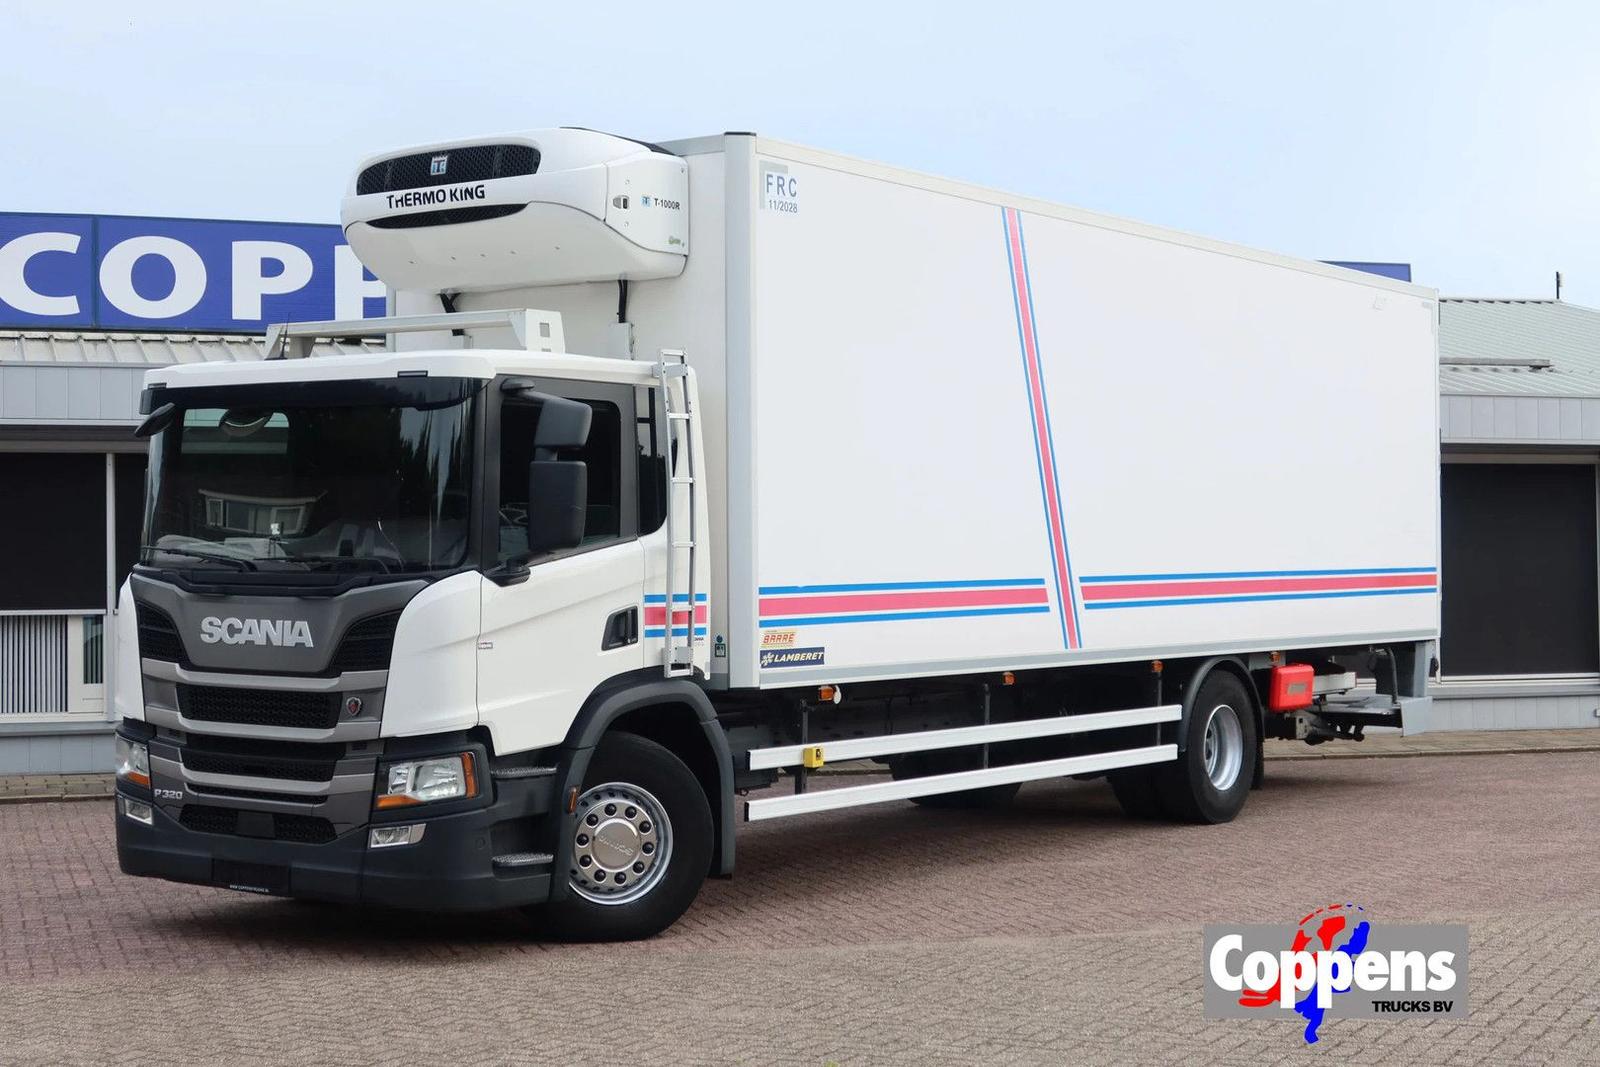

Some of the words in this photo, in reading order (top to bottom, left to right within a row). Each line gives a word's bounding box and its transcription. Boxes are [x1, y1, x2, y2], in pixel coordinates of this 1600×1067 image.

[766, 173, 797, 197] FRC
[386, 189, 447, 209] THERMO
[449, 184, 486, 202] KING
[653, 197, 681, 210] T-1000R
[768, 199, 798, 213] 11/2028
[200, 616, 314, 648] SCANIA
[774, 652, 824, 663] LAMBERET
